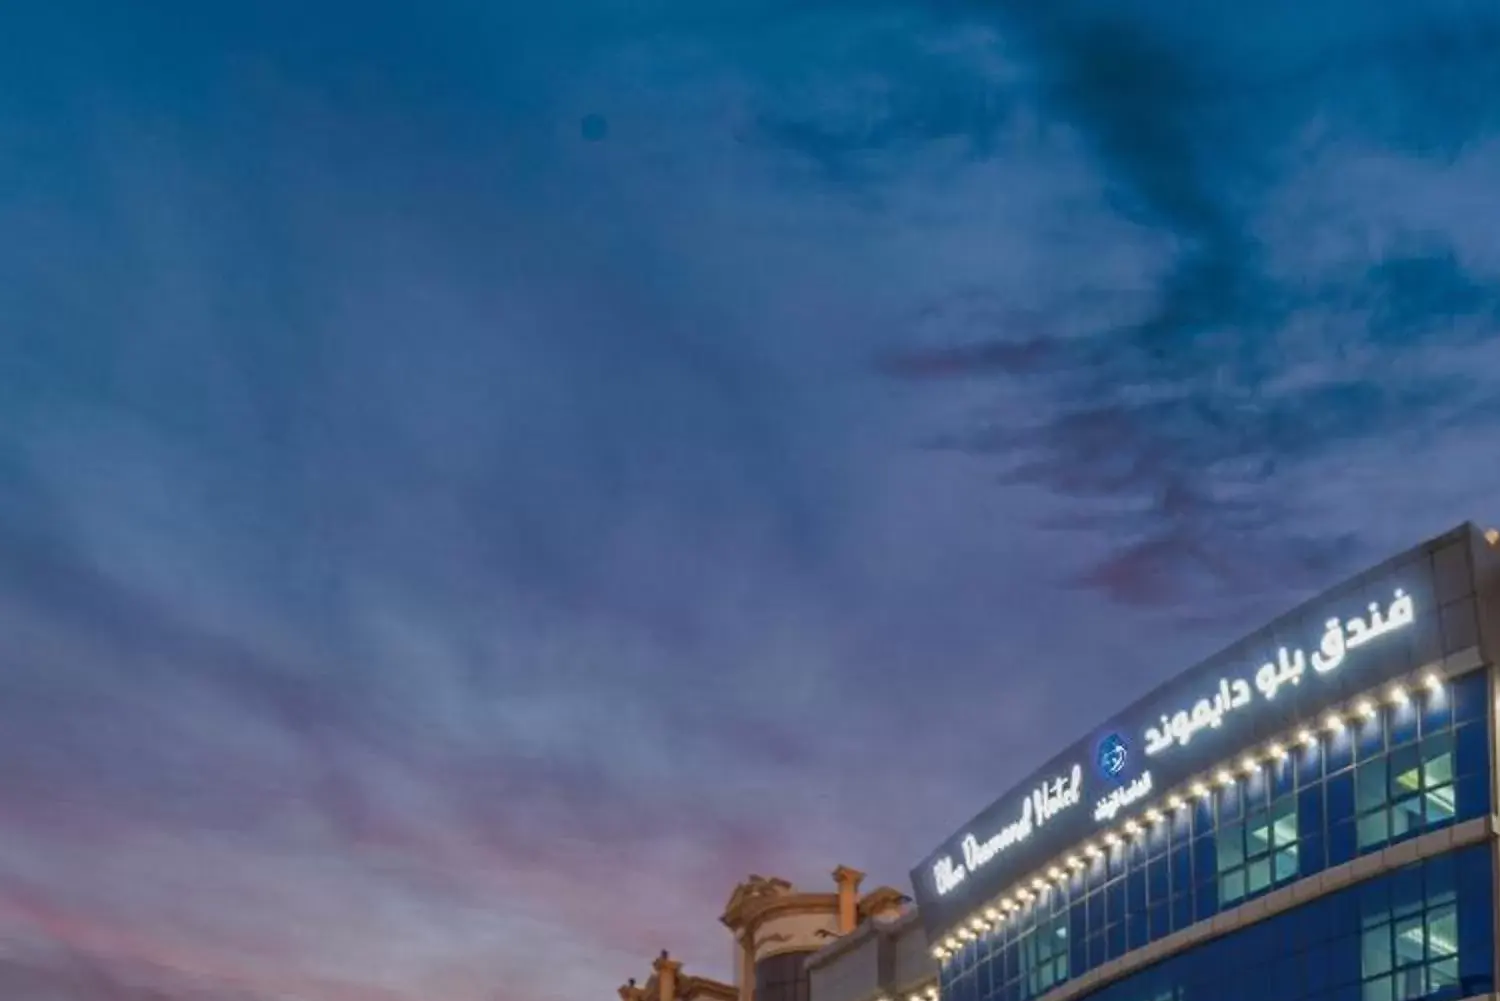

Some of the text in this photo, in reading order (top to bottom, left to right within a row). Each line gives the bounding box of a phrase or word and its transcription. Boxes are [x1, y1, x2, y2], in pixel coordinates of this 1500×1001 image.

[1144, 588, 1414, 756] فندق بلو دايموند
